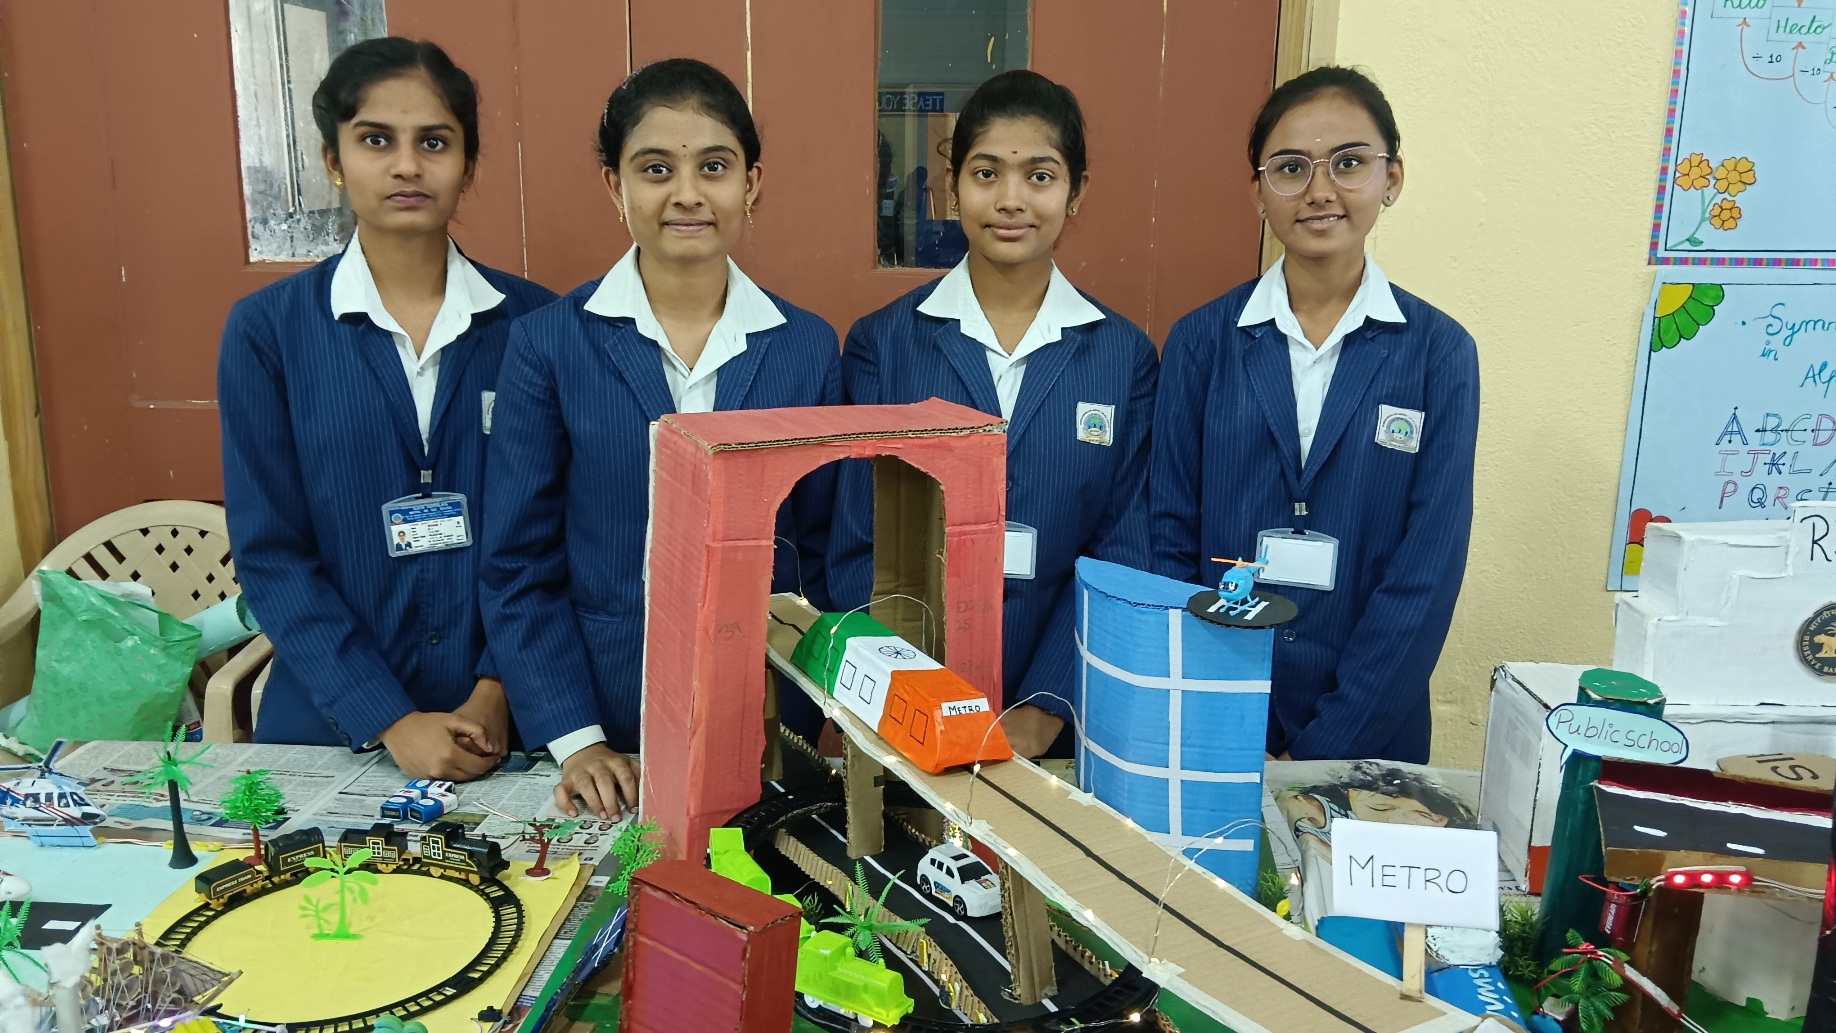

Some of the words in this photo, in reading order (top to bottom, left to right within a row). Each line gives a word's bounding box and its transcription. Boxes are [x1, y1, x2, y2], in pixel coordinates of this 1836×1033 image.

[1776, 15, 1833, 36] Hecto
[1759, 340, 1779, 361] in
[1803, 635, 1822, 669] RESERVE
[948, 705, 981, 716] METRO
[1555, 709, 1620, 744] Public
[287, 850, 315, 863] EXPRESS
[216, 879, 238, 892] EXPRESS
[238, 874, 252, 884] TRAIN
[1349, 854, 1468, 894] METRO
